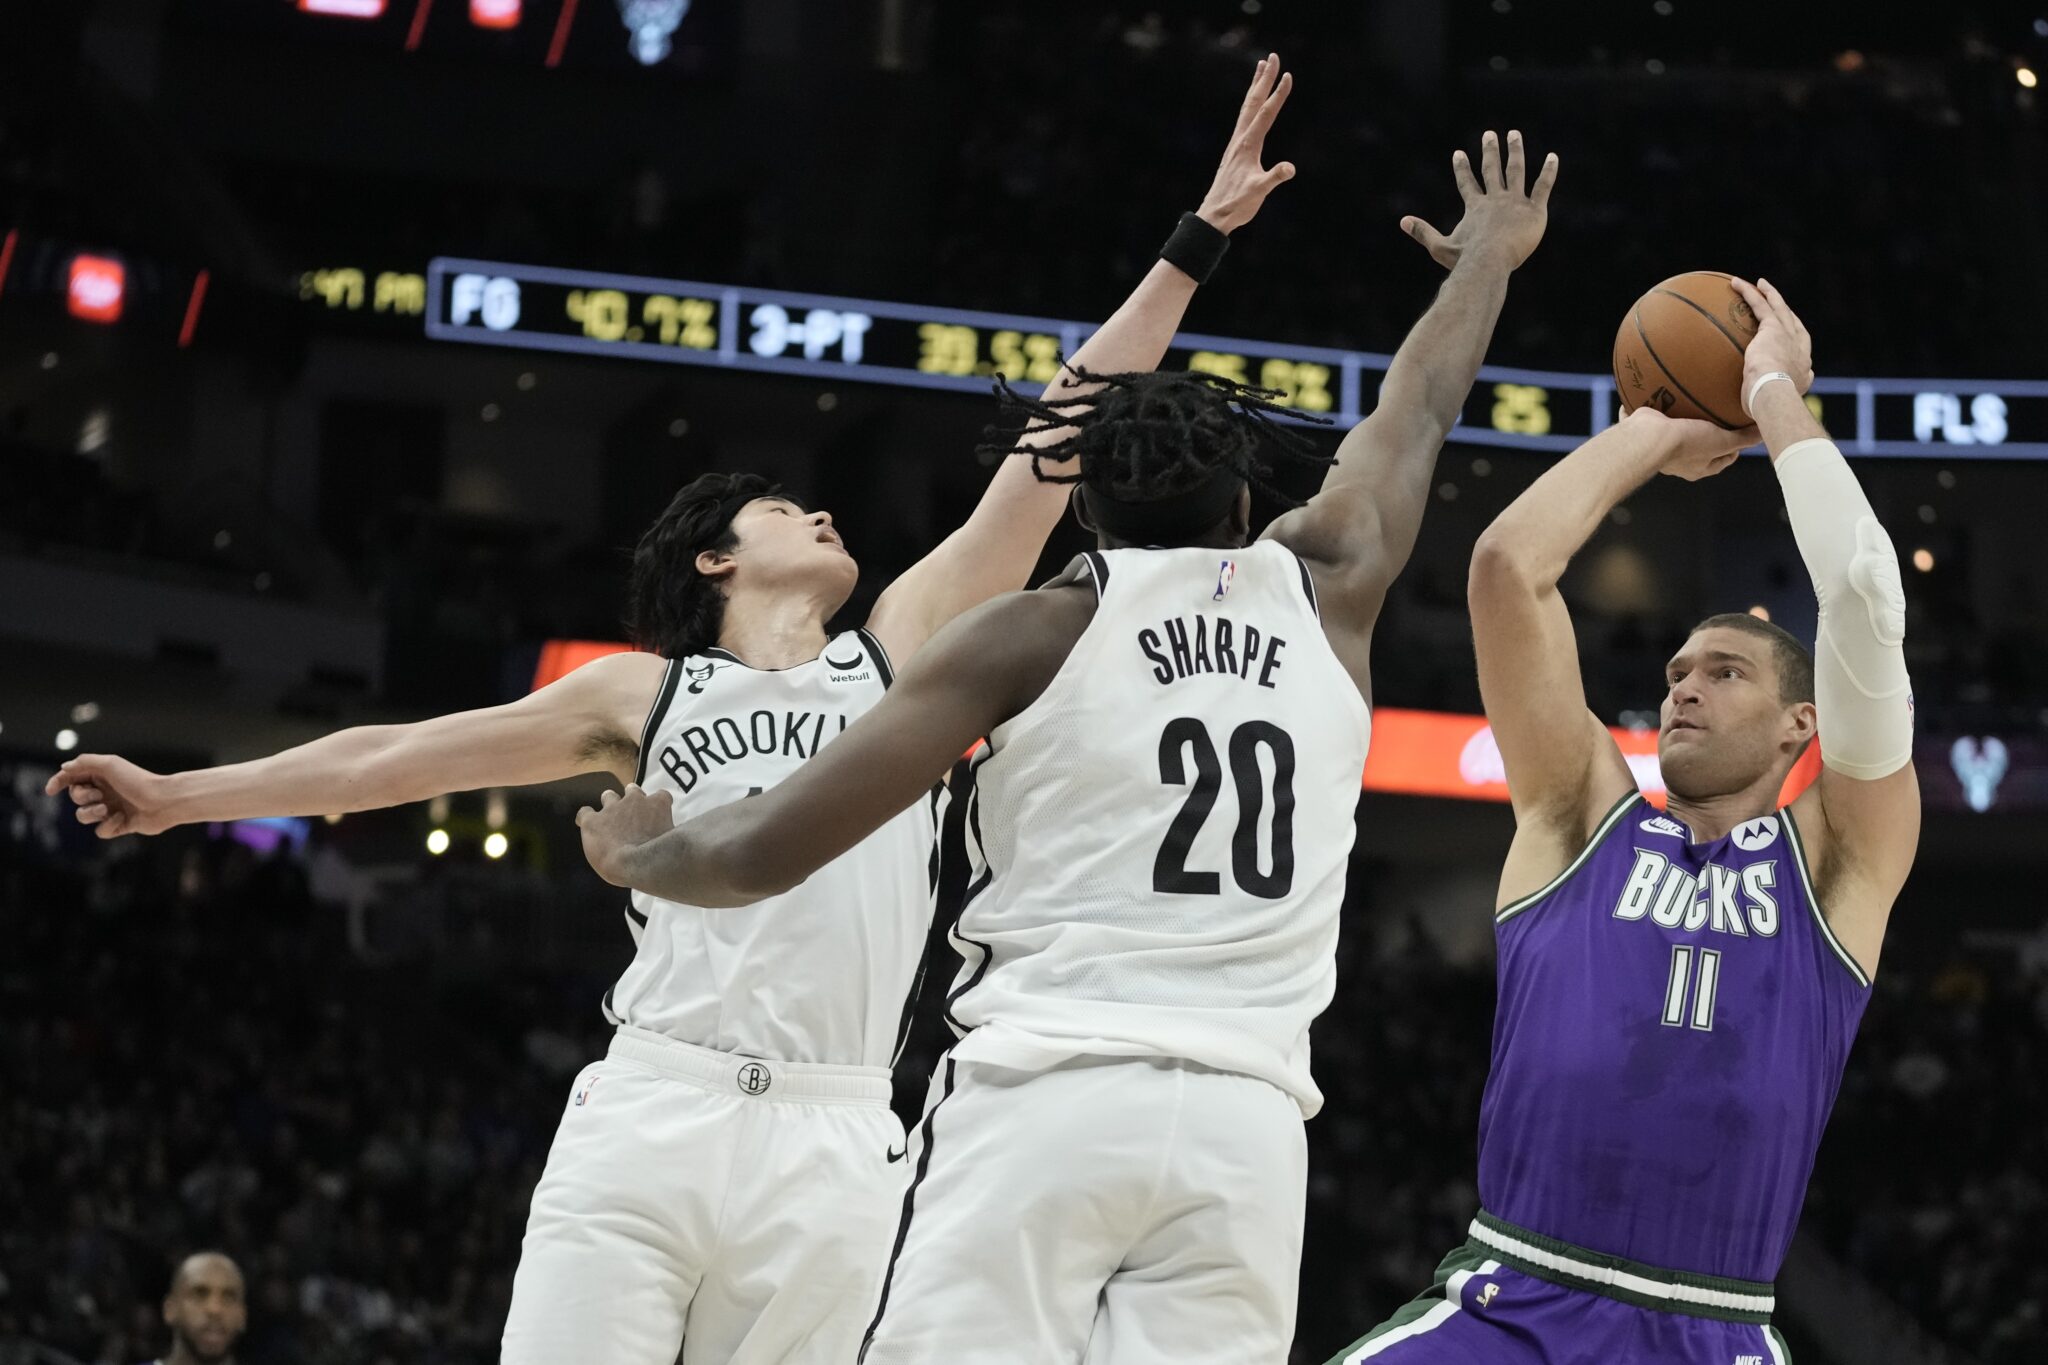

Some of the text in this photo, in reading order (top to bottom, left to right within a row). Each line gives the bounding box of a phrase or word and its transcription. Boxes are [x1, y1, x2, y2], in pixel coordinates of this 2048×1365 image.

[451, 272, 521, 332] FG
[749, 304, 872, 365] 3-PT
[1914, 392, 2008, 445] FLS
[829, 671, 870, 682] Webull
[1138, 614, 1287, 689] SHARPE
[1153, 717, 1295, 900] 20
[1649, 816, 1685, 835] NIKE
[1612, 846, 1779, 937] BUCKS
[1661, 944, 1722, 1031] 11
